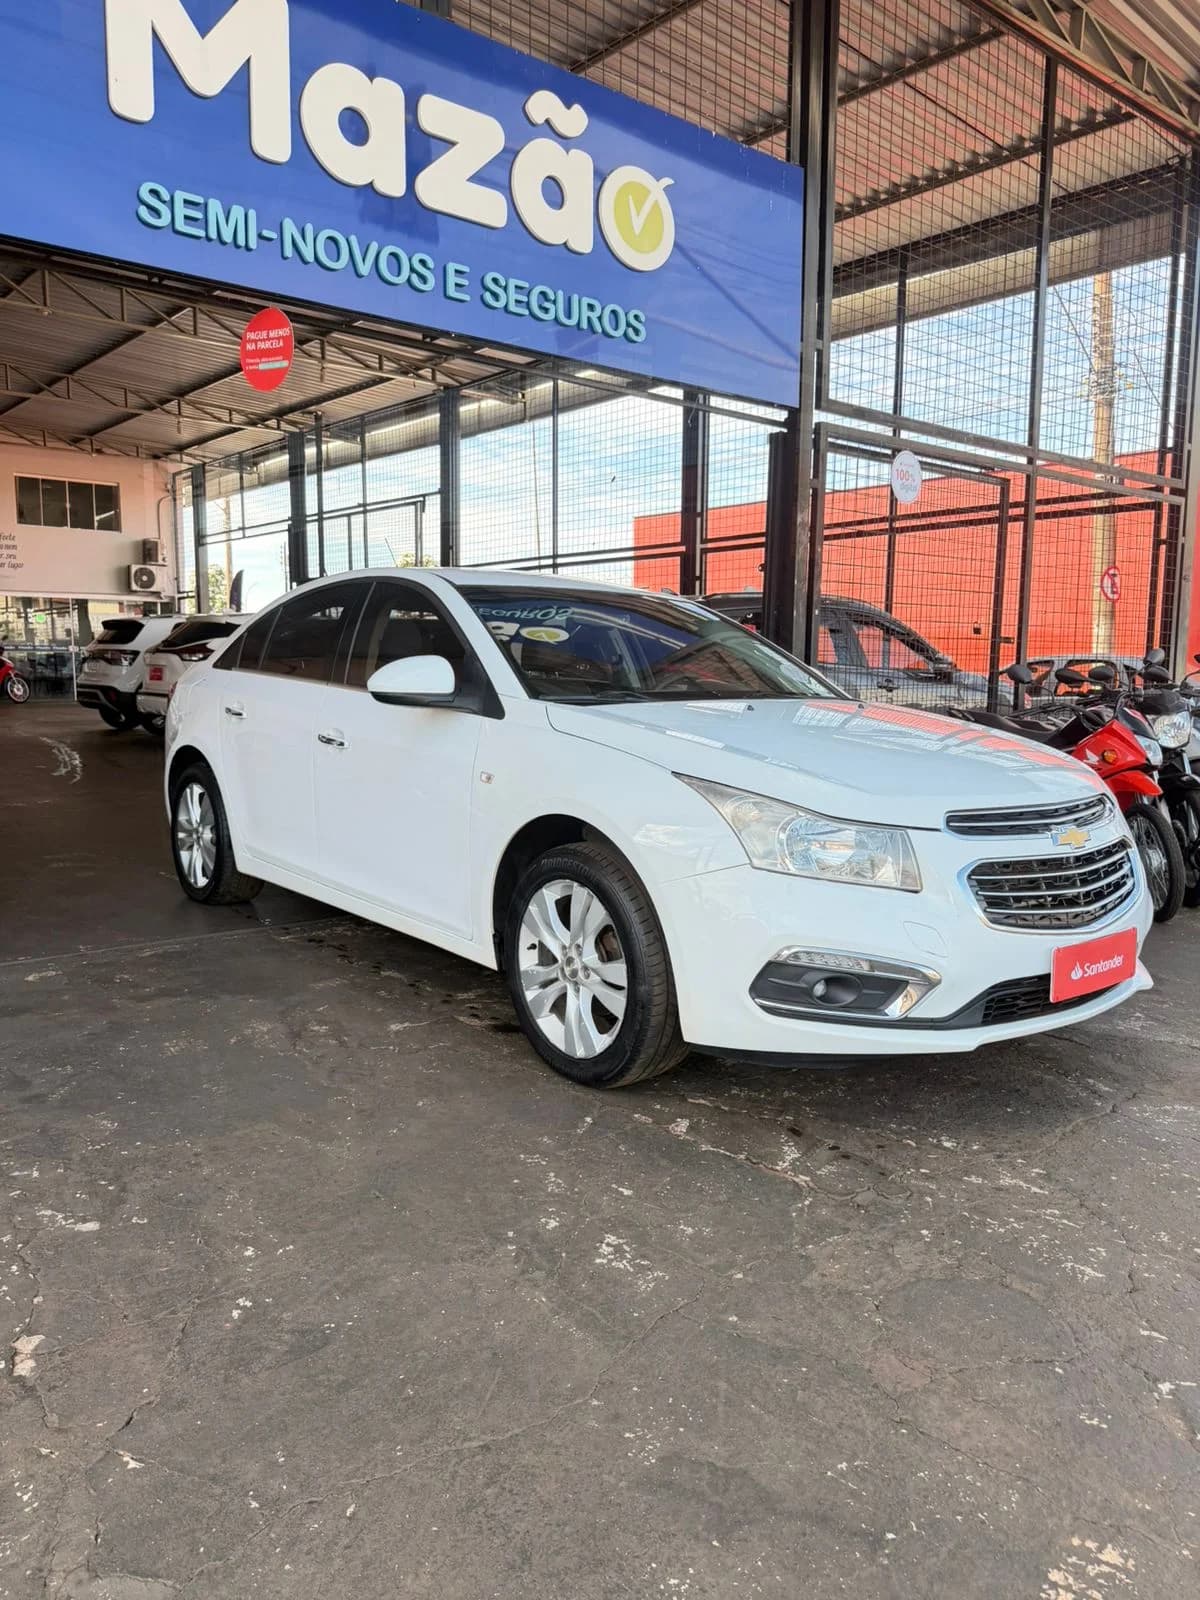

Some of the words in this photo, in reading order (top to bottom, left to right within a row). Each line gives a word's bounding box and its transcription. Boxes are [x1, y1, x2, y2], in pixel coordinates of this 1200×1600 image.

[104, 0, 675, 272] Mazão
[136, 181, 435, 292] SEMI-NOVOS
[444, 261, 471, 302] E
[481, 271, 646, 343] SEGUROS
[247, 330, 267, 340] PAGUE
[269, 328, 290, 338] MENOS
[247, 342, 256, 351] NA
[257, 339, 283, 350] PARCELA
[1084, 954, 1124, 977] Santander
